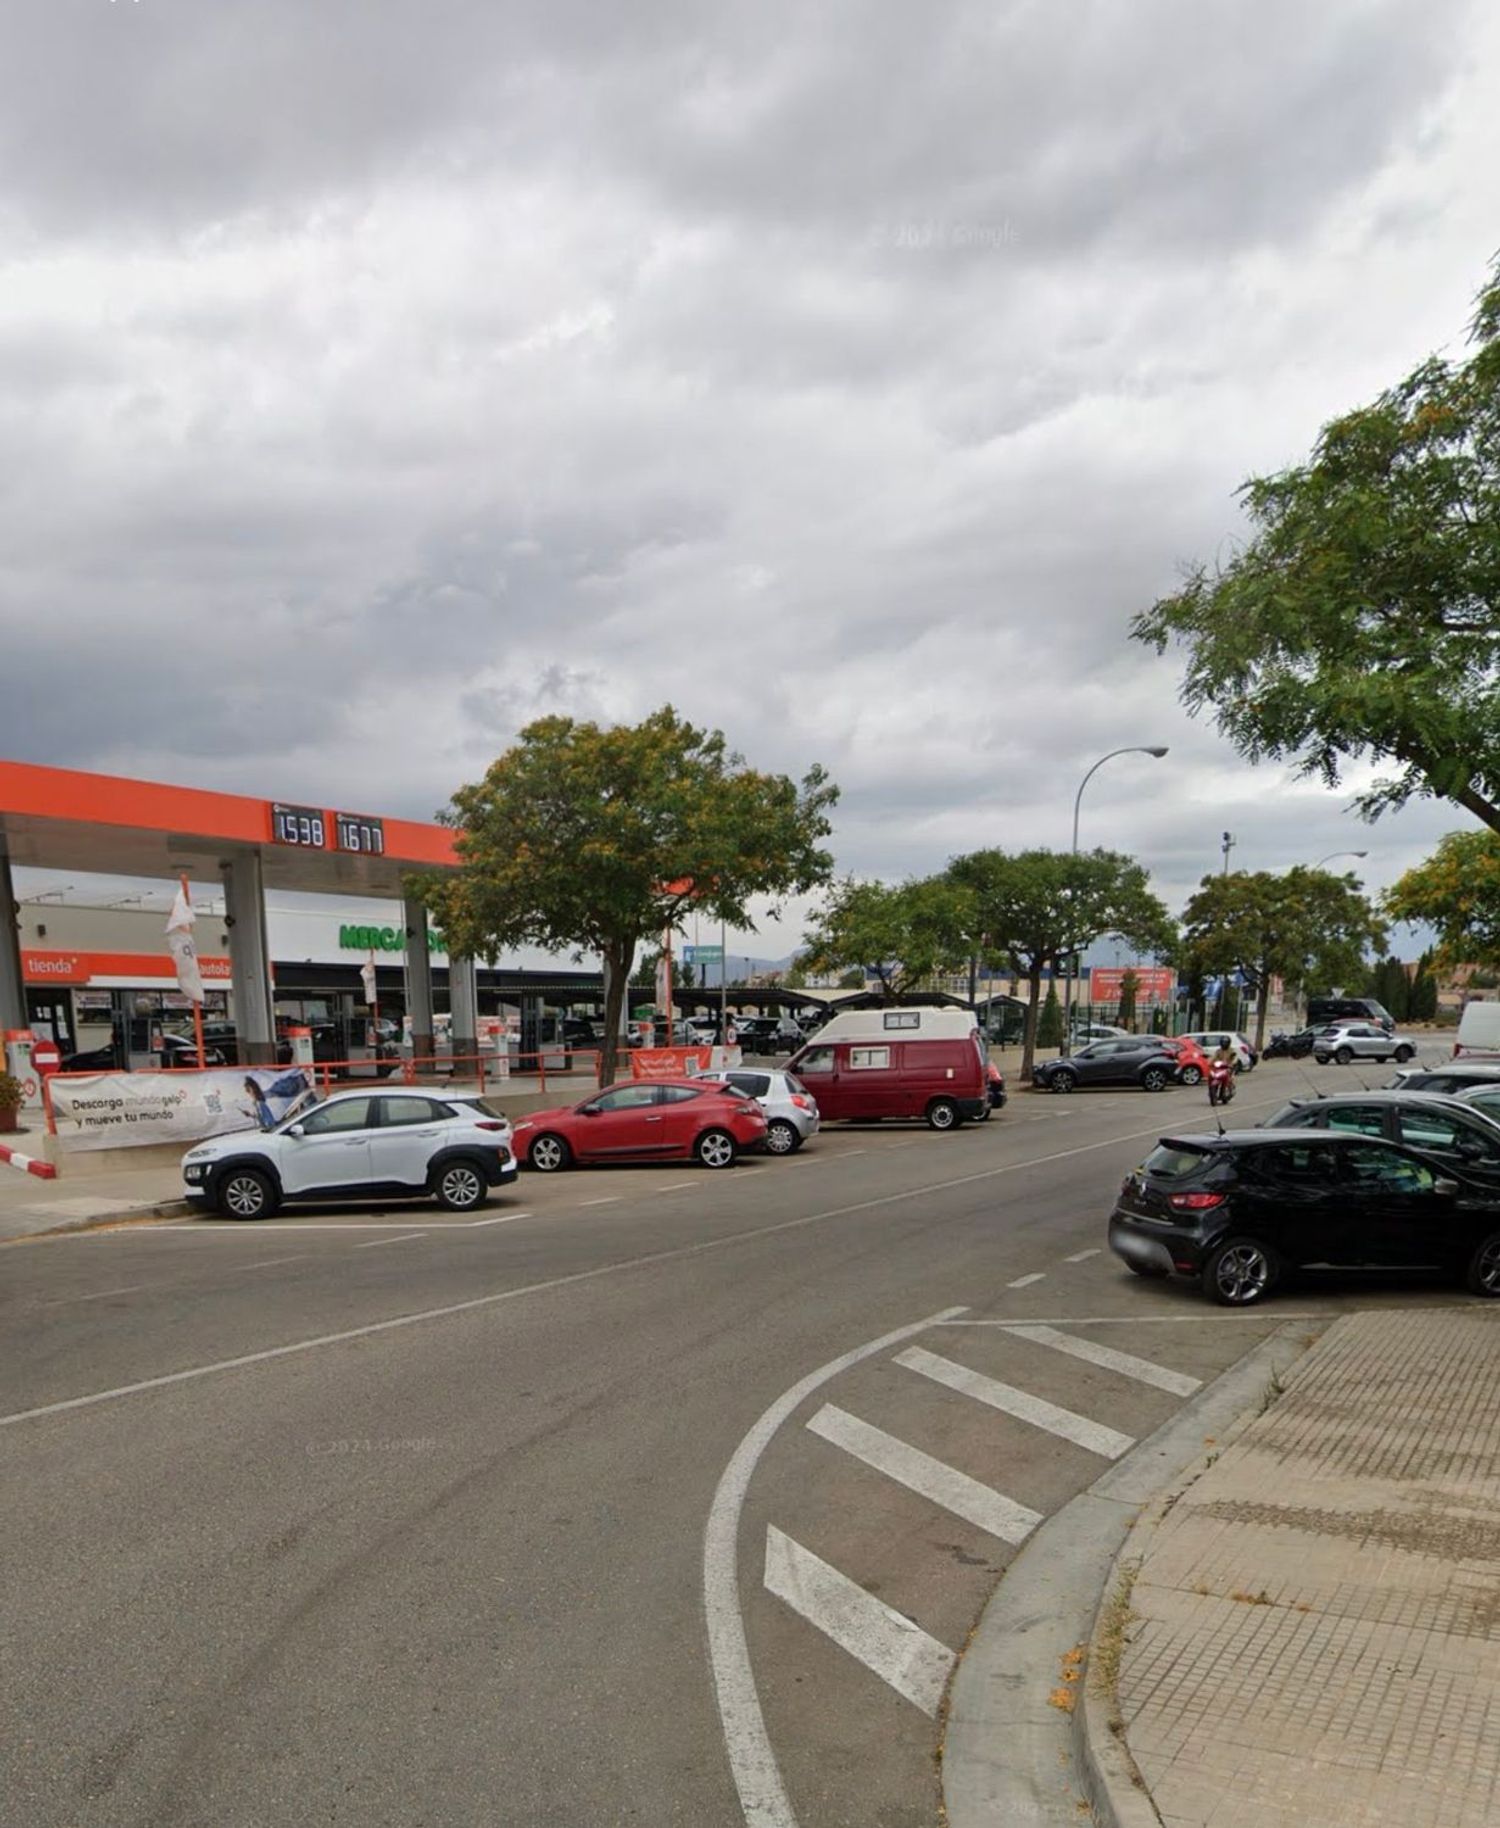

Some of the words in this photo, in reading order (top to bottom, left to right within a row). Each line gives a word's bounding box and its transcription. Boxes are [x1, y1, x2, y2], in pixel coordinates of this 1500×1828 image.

[28, 959, 71, 974] tienda
[72, 1098, 123, 1110] Descarga
[75, 1116, 83, 1128] y
[85, 1114, 122, 1126] mueve
[124, 1112, 138, 1123] tu
[139, 1109, 174, 1121] mundo
